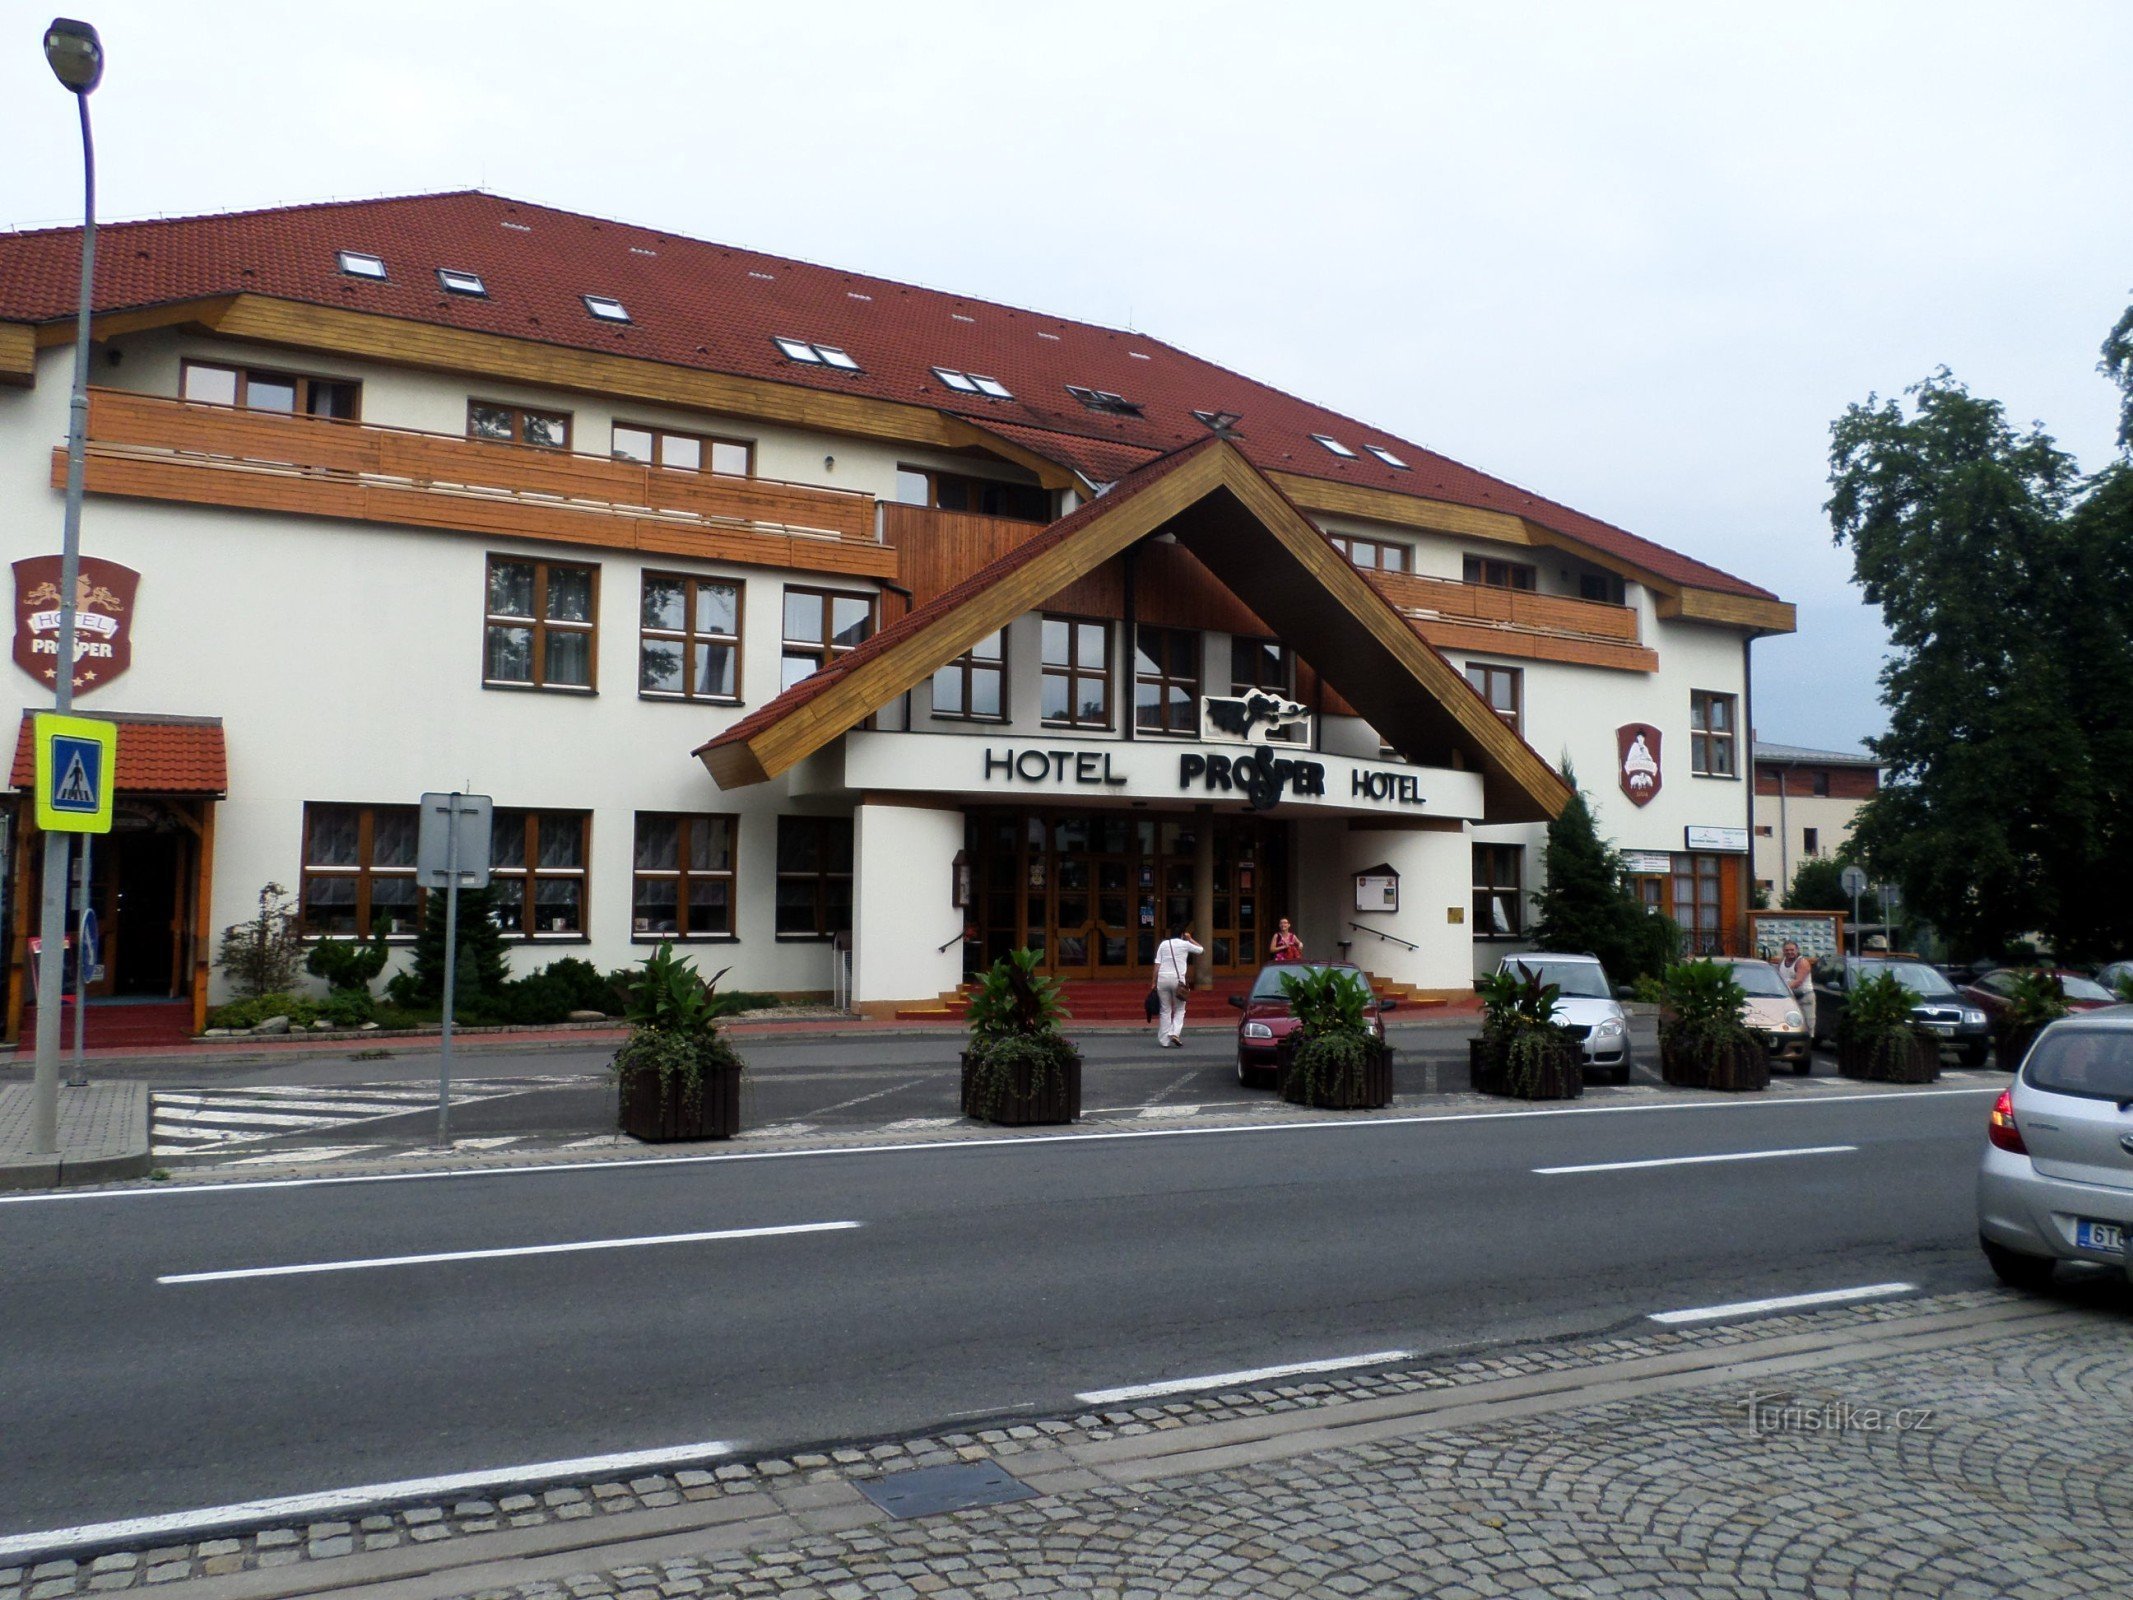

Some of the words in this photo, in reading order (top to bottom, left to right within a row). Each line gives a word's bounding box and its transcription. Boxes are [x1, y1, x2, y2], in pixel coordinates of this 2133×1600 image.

[39, 612, 109, 631] HEL
[32, 636, 113, 662] PRSPER
[984, 748, 1127, 785] HOTEL
[1180, 745, 1325, 810] PROSPER
[1352, 768, 1427, 804] HOTEL
